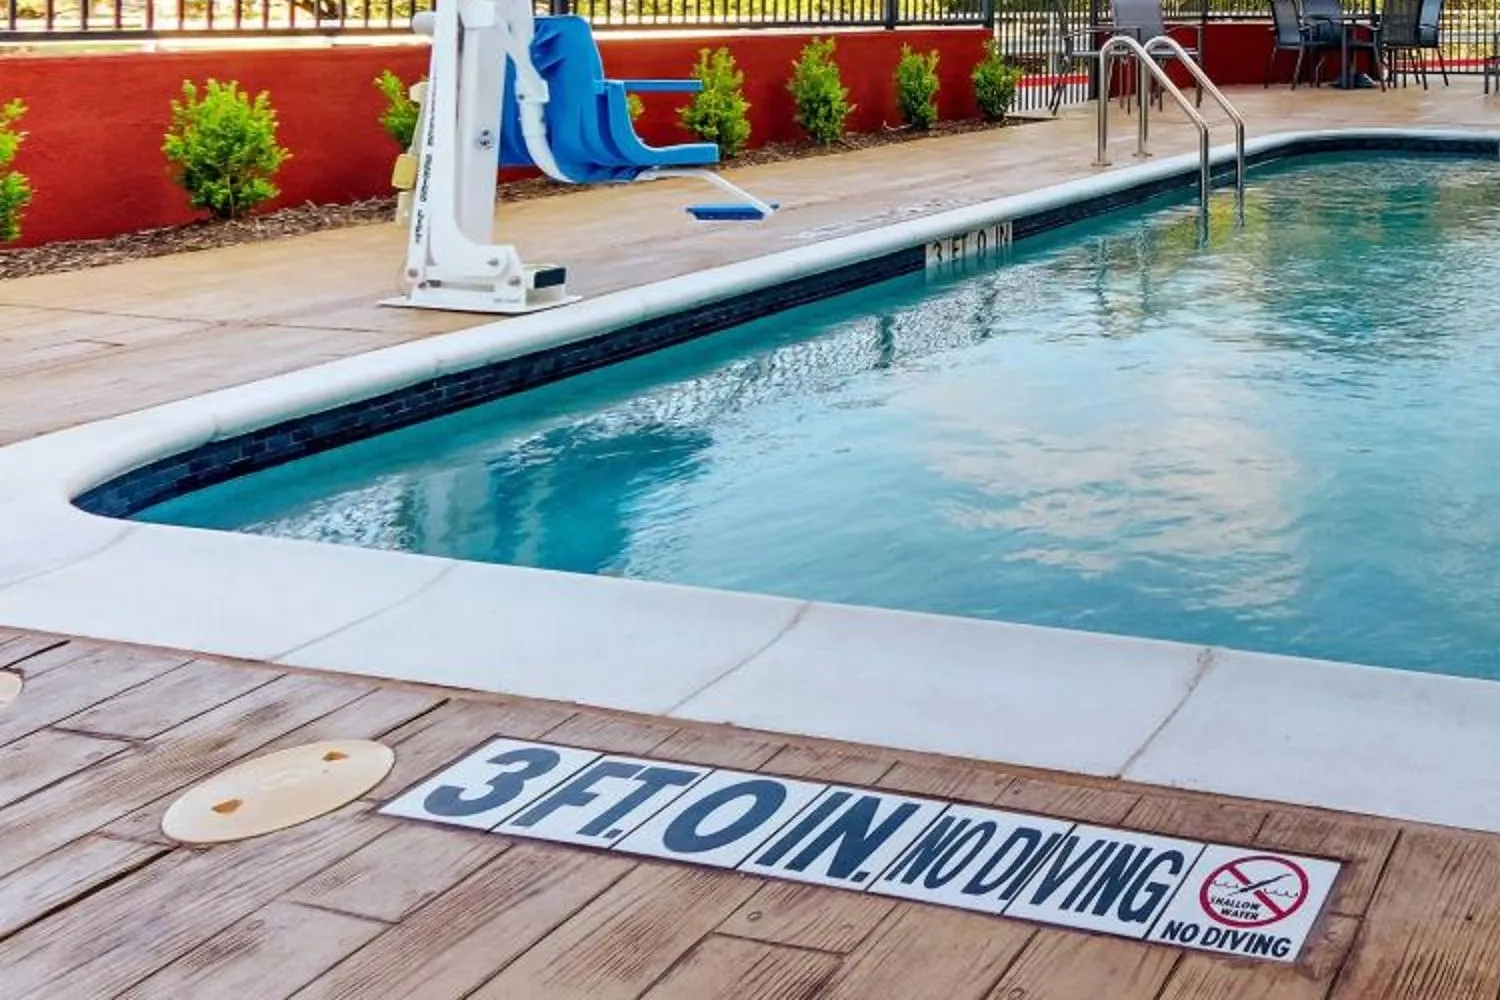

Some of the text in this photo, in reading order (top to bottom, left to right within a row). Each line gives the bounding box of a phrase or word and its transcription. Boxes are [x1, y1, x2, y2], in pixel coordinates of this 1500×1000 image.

[424, 748, 561, 817] 3
[754, 791, 921, 883] IN.
[884, 815, 998, 889] NO
[960, 827, 1185, 923] DIVING
[1211, 896, 1261, 911] SHALLOW
[1220, 907, 1260, 921] WATER
[1161, 919, 1292, 957] NO DIVING
